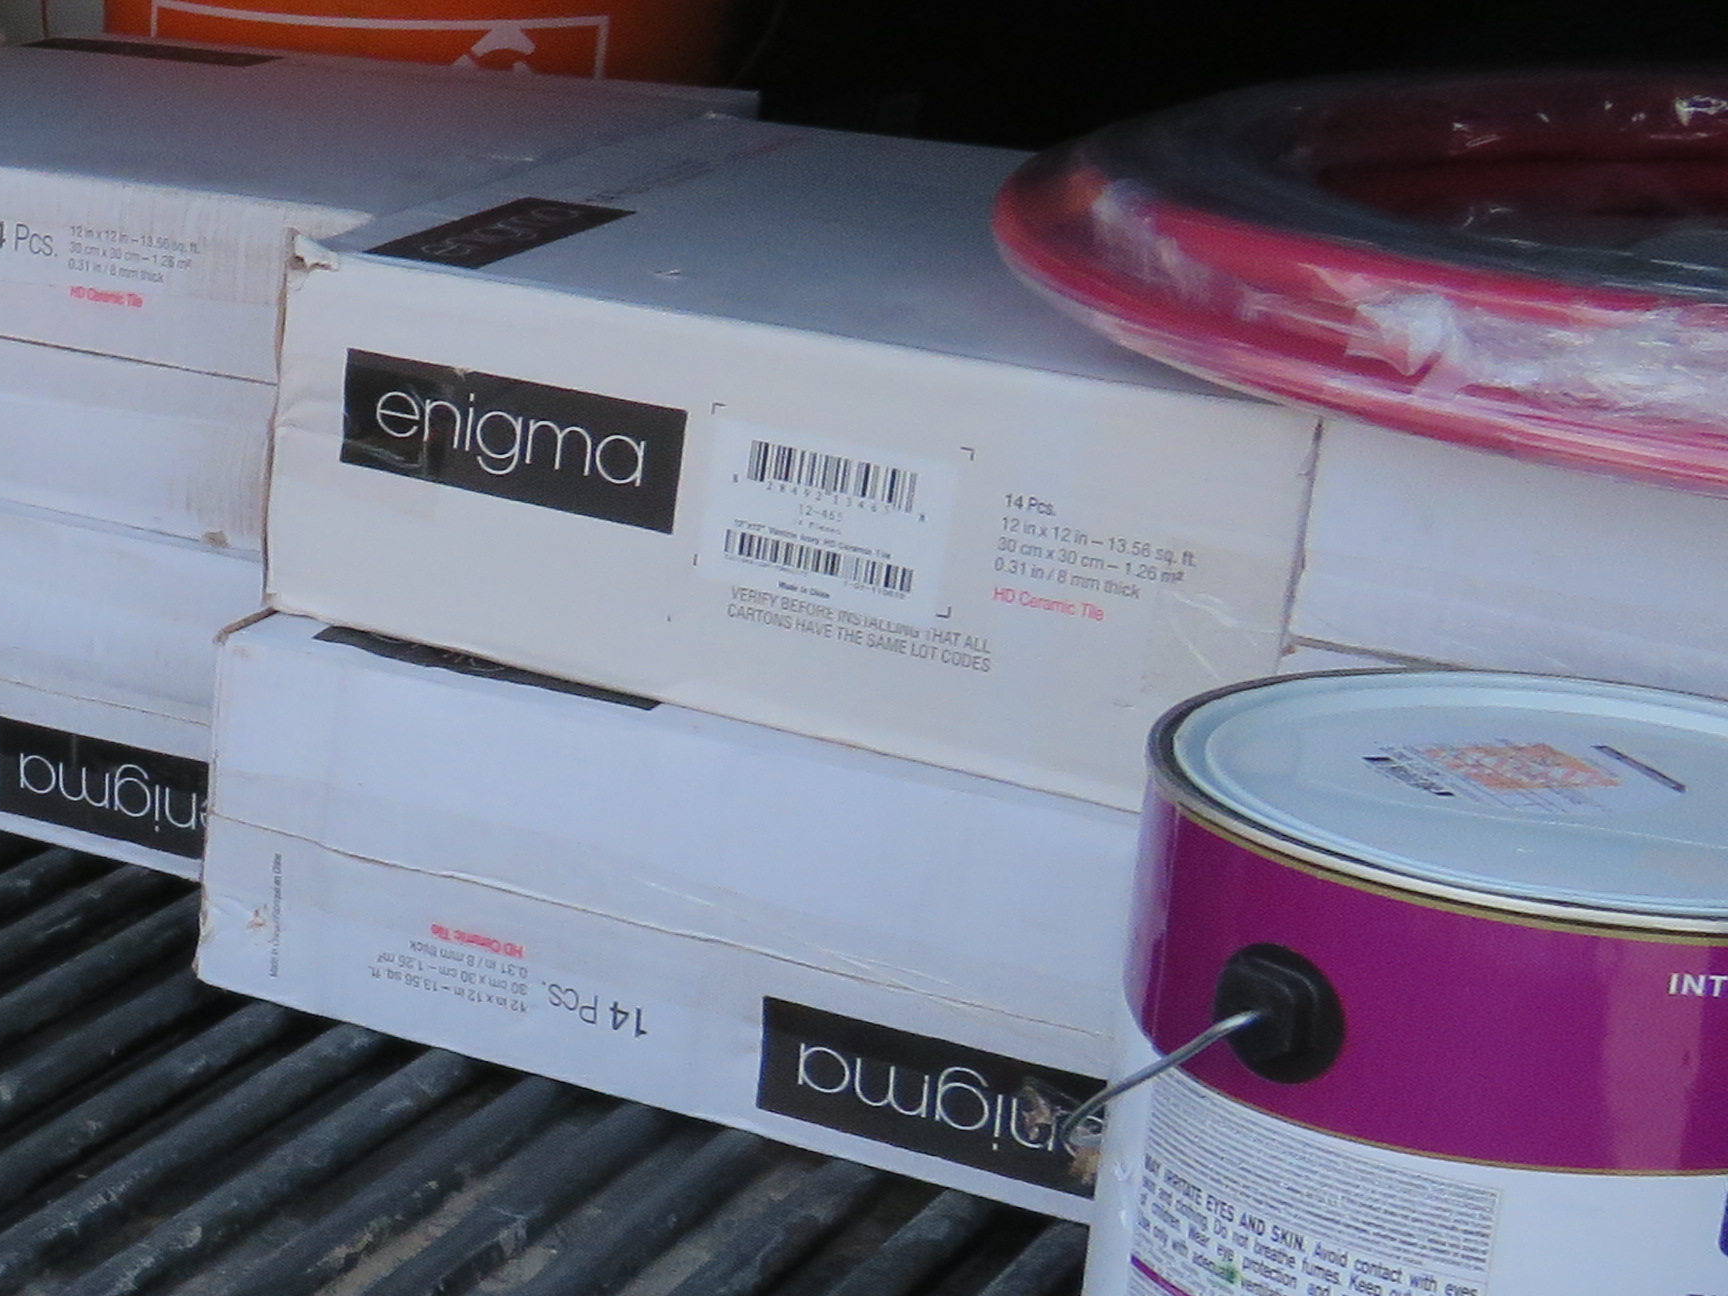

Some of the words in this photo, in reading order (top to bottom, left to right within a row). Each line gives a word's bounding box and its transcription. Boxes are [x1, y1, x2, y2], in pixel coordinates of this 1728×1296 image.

[14, 222, 58, 258] Pcs.
[376, 391, 646, 487] enigma
[1005, 493, 1024, 510] 14
[1028, 497, 1056, 517] Pcs.
[997, 536, 1016, 553] 30
[1020, 544, 1043, 558] cm
[1058, 548, 1077, 565] 30
[1081, 555, 1104, 570] cm
[1125, 562, 1157, 581] 1.26
[1002, 517, 1020, 534] 12
[1023, 521, 1037, 536] in
[1053, 526, 1072, 543] 12
[1074, 529, 1088, 546] in
[1108, 537, 1151, 558] 13.56
[1154, 547, 1177, 566] sq.
[994, 556, 1026, 574] 0.31
[1030, 564, 1043, 579] in
[1057, 569, 1067, 584] 8
[1069, 573, 1100, 592] mm
[1104, 578, 1141, 599] thick
[731, 586, 778, 608] VERIFY
[781, 595, 834, 621] BEFORE
[838, 607, 920, 639] INSTALLING
[924, 626, 962, 648] THAT
[964, 635, 991, 655] ALL
[993, 586, 1016, 604] HD
[1019, 590, 1076, 616] Ceramic
[1081, 602, 1104, 621] Tile
[727, 603, 793, 630] CARTONS
[795, 618, 833, 639] HAVE
[836, 626, 863, 646] THE
[865, 632, 908, 654] SAME
[909, 642, 940, 661] LOT
[940, 647, 992, 673] CODES
[442, 965, 458, 977] cm
[461, 970, 476, 985] 30
[488, 978, 508, 991] cm
[501, 962, 528, 979] 0.31
[1668, 972, 1728, 998] INT
[467, 989, 482, 1003] 12
[511, 982, 528, 996] 30
[511, 999, 527, 1014] 12
[542, 980, 598, 1024] Pcs.
[609, 1001, 648, 1038] 14
[1206, 1193, 1235, 1222] EYES
[1240, 1212, 1265, 1236] AND
[1270, 1224, 1305, 1253] SKIN.
[1313, 1241, 1348, 1267] Avoid
[1354, 1258, 1402, 1284] contact
[1409, 1272, 1437, 1293] with
[1214, 1218, 1227, 1239] Do
[1254, 1238, 1296, 1268] breathe
[1302, 1257, 1341, 1286] fumes.
[1242, 1256, 1297, 1289] protection
